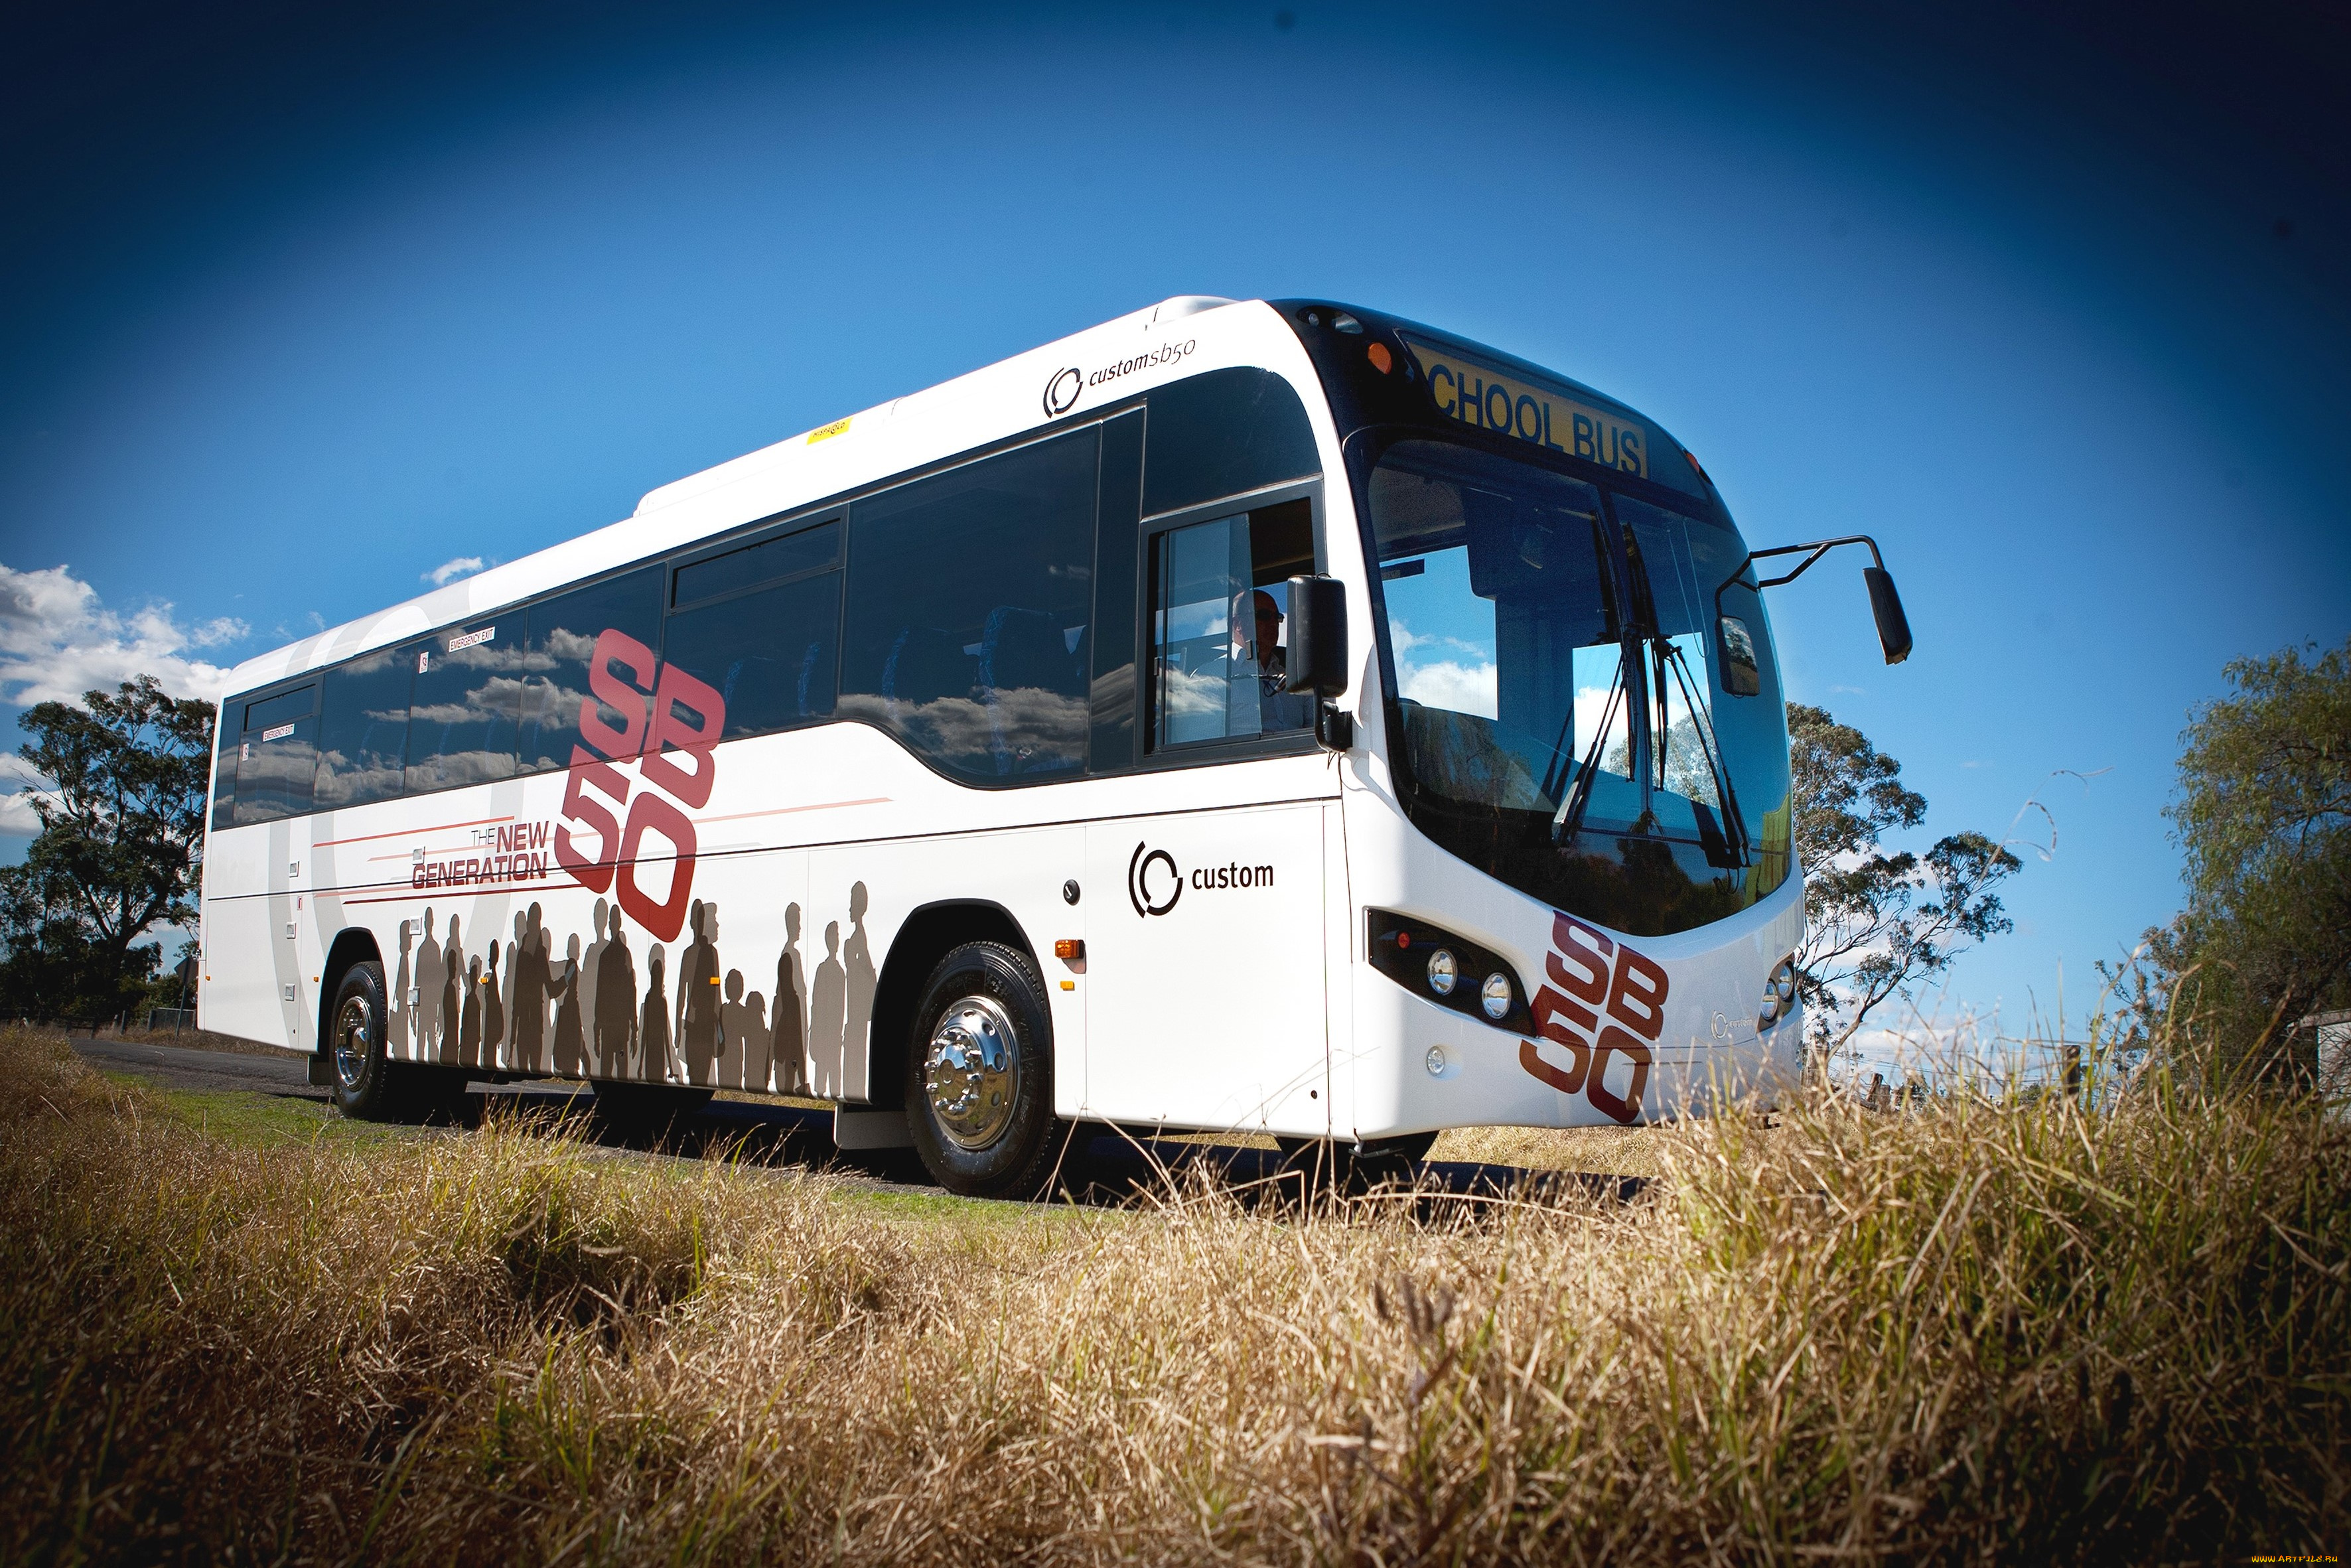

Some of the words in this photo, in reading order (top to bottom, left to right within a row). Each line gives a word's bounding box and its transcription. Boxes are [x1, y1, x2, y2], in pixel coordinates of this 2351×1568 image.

[1428, 364, 1564, 453] CHOOL
[1572, 412, 1642, 477] BUS
[451, 634, 481, 650] EMERGENCY
[482, 629, 494, 641] EXIT
[470, 827, 496, 847] THE
[496, 820, 549, 853] NEW
[412, 851, 547, 890] GENERATION
[1192, 861, 1273, 890] custom
